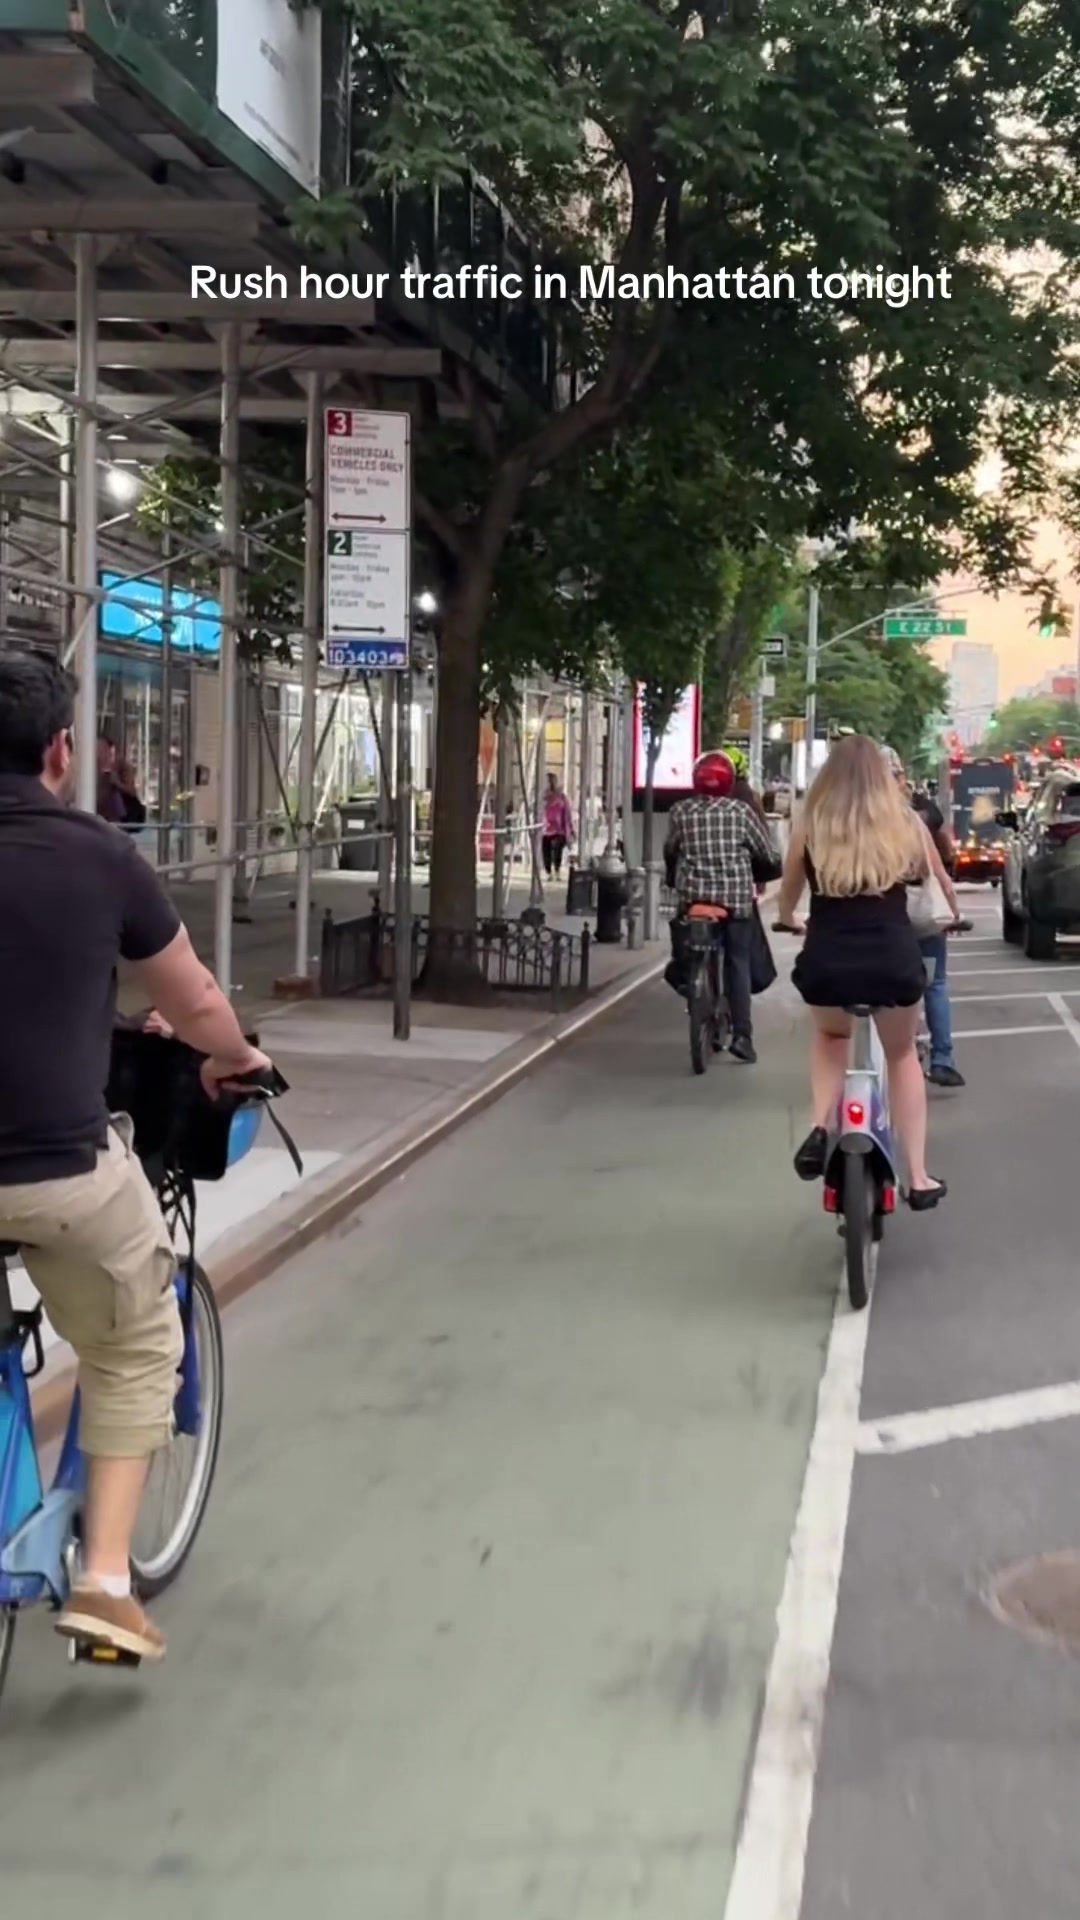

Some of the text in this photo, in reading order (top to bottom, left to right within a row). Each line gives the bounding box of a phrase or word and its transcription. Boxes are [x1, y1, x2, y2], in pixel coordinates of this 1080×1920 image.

[334, 412, 347, 434] 3
[330, 446, 394, 459] COMMERCIAL
[331, 459, 403, 472] VEHICLES ONLY
[333, 532, 347, 554] 2
[900, 621, 908, 633] E
[912, 621, 931, 633] 22
